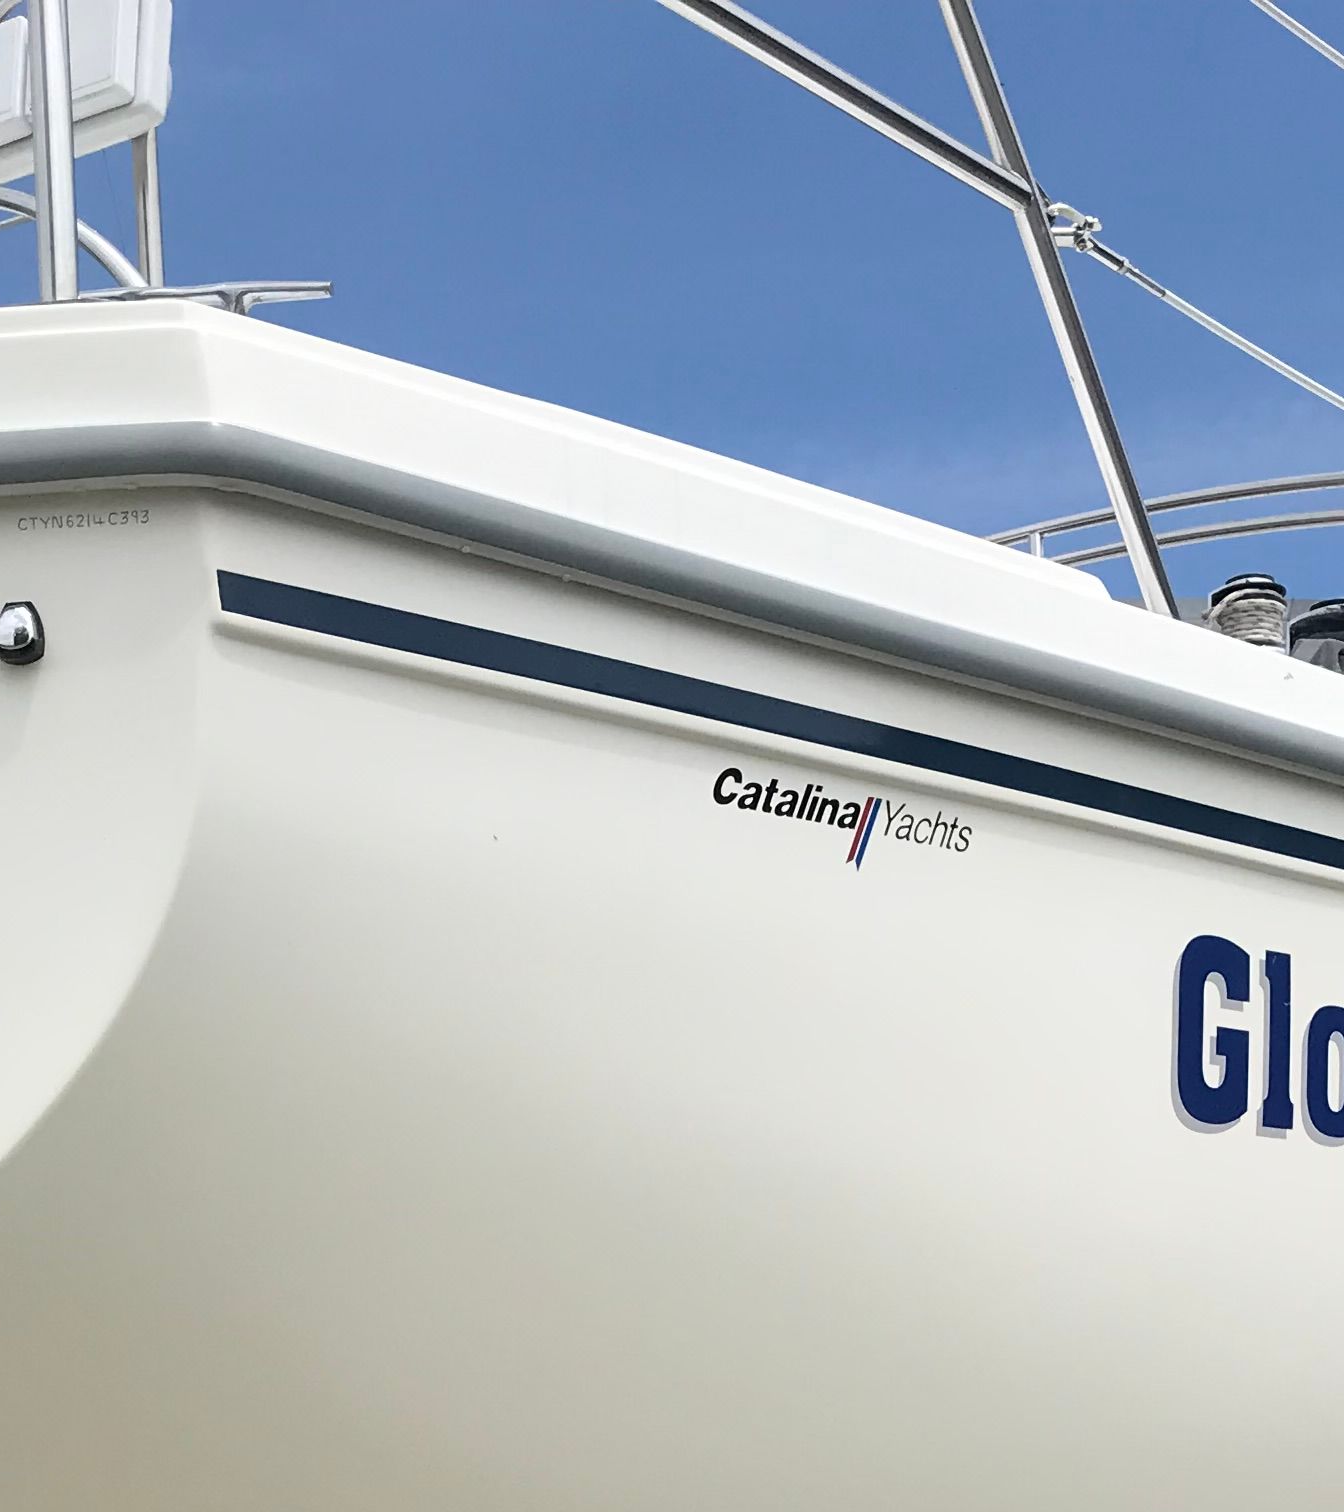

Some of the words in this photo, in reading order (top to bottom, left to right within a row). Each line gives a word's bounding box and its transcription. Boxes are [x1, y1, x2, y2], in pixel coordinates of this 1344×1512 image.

[17, 510, 150, 531] CTYN6214C393
[712, 767, 861, 829] Catalina
[884, 799, 973, 852] Yachts
